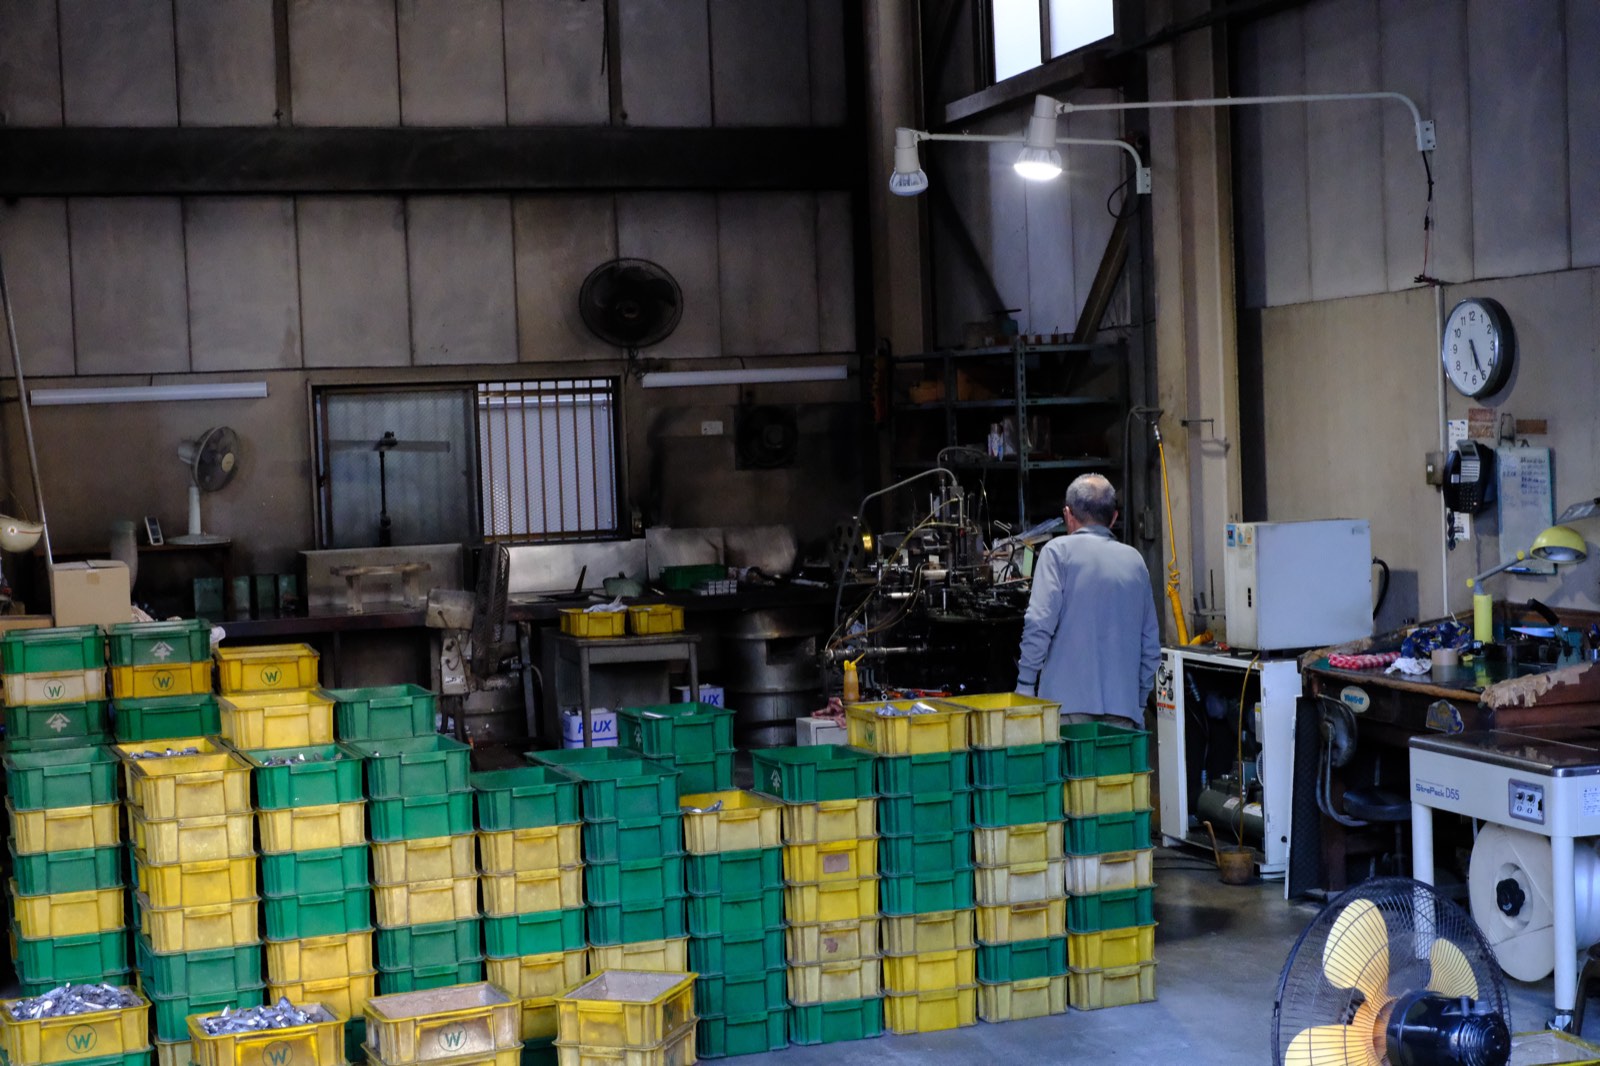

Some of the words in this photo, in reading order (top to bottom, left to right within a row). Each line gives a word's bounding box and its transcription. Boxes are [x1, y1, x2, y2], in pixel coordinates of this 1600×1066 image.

[1461, 316, 1467, 326] 11
[1468, 311, 1476, 321] 12
[1480, 314, 1484, 323] 1
[1454, 328, 1462, 338] 10
[1486, 324, 1492, 335] 2
[1453, 345, 1458, 354] 9
[1490, 341, 1495, 351] 3
[1456, 361, 1461, 371] 8
[1488, 358, 1493, 367] 4
[1463, 372, 1468, 382] 7
[1472, 375, 1477, 385] 6
[1446, 787, 1460, 801] D55
